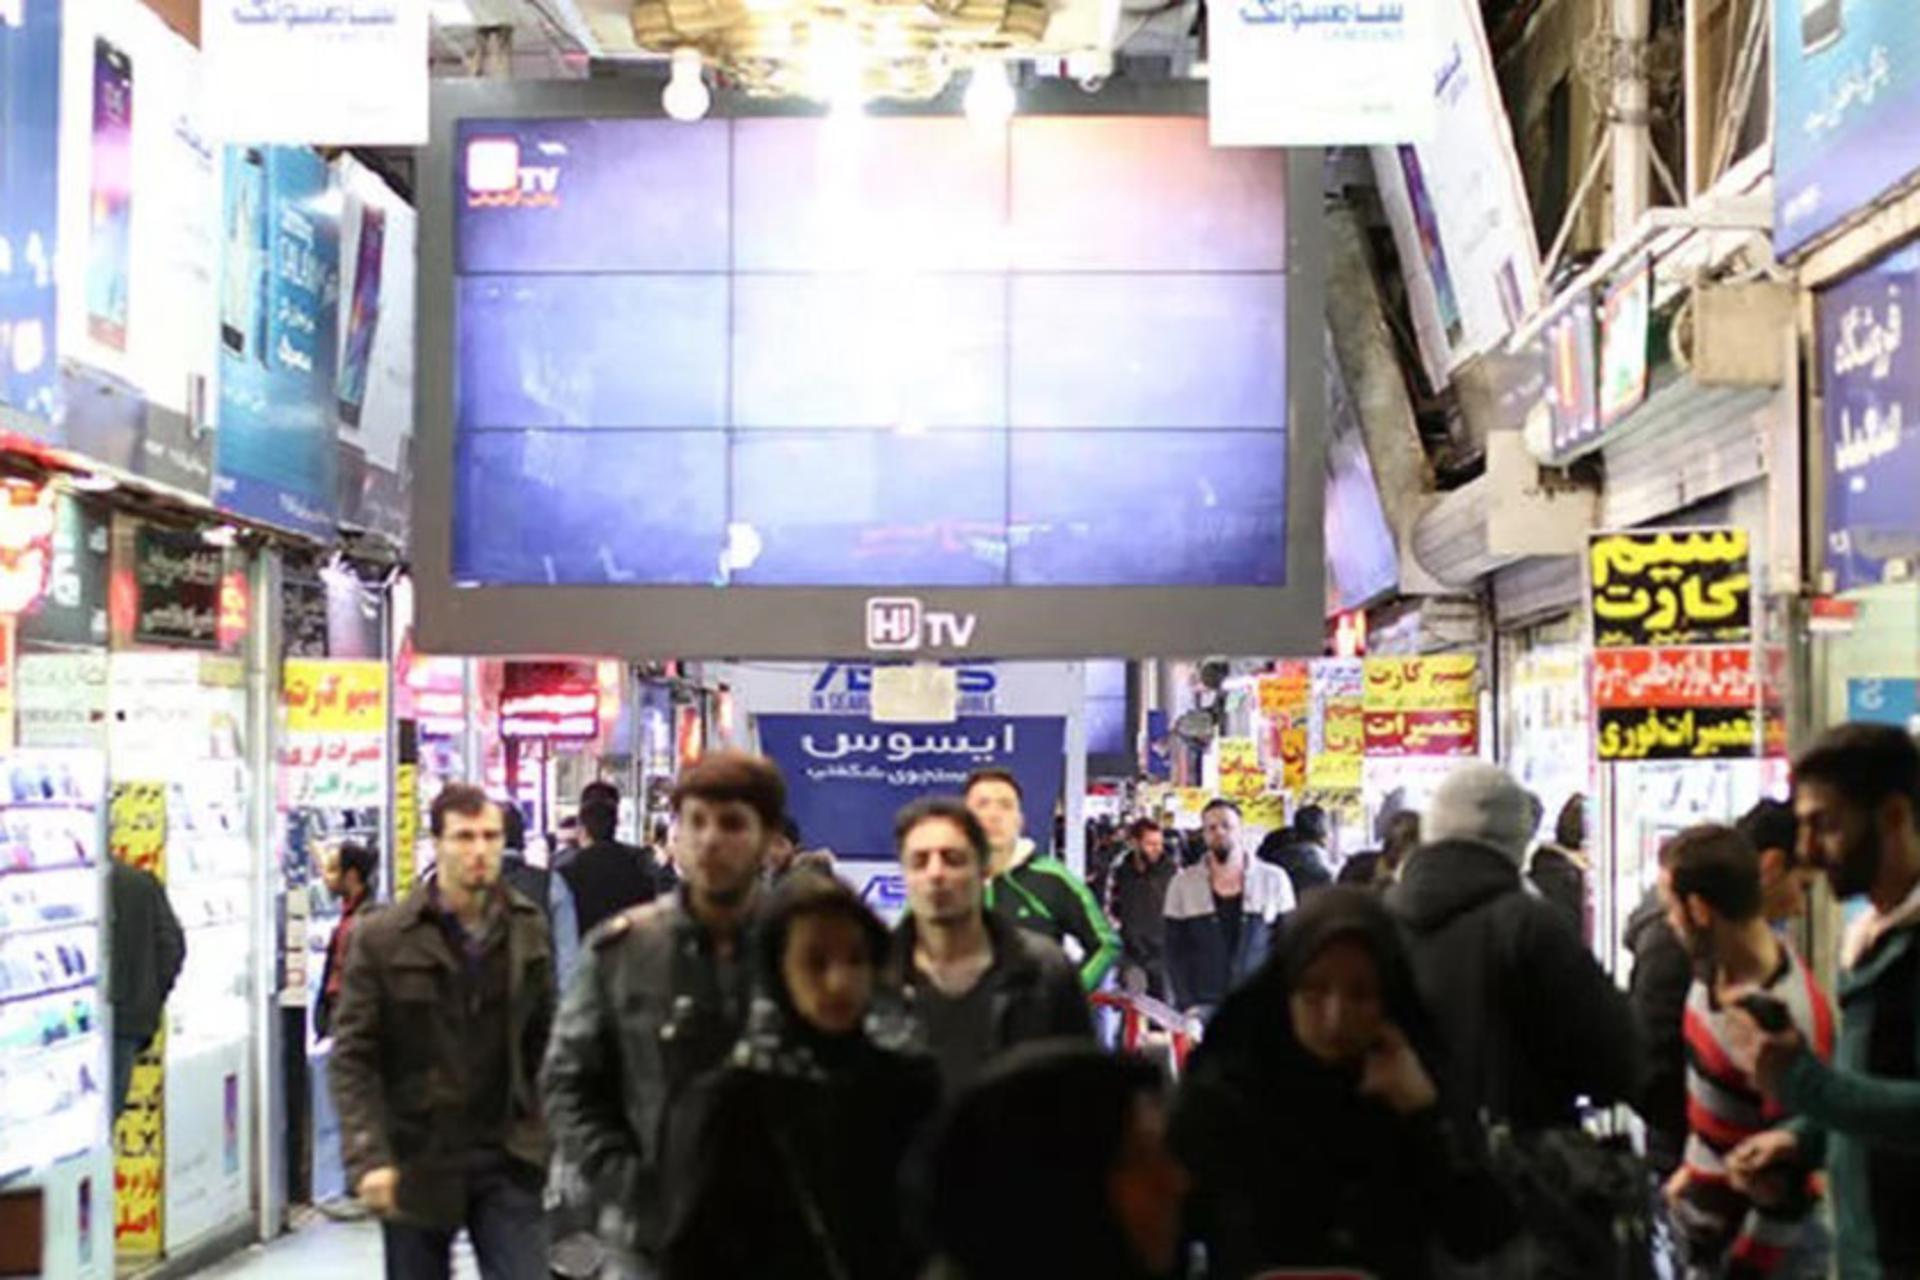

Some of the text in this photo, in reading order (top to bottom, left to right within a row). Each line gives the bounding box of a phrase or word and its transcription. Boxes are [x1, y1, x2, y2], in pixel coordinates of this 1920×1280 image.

[1592, 528, 1749, 587] سیم
[1594, 574, 1750, 631] کارت
[925, 612, 976, 647] TV
[802, 724, 1015, 762] ایسوس
[1366, 712, 1473, 747] تعمیرات
